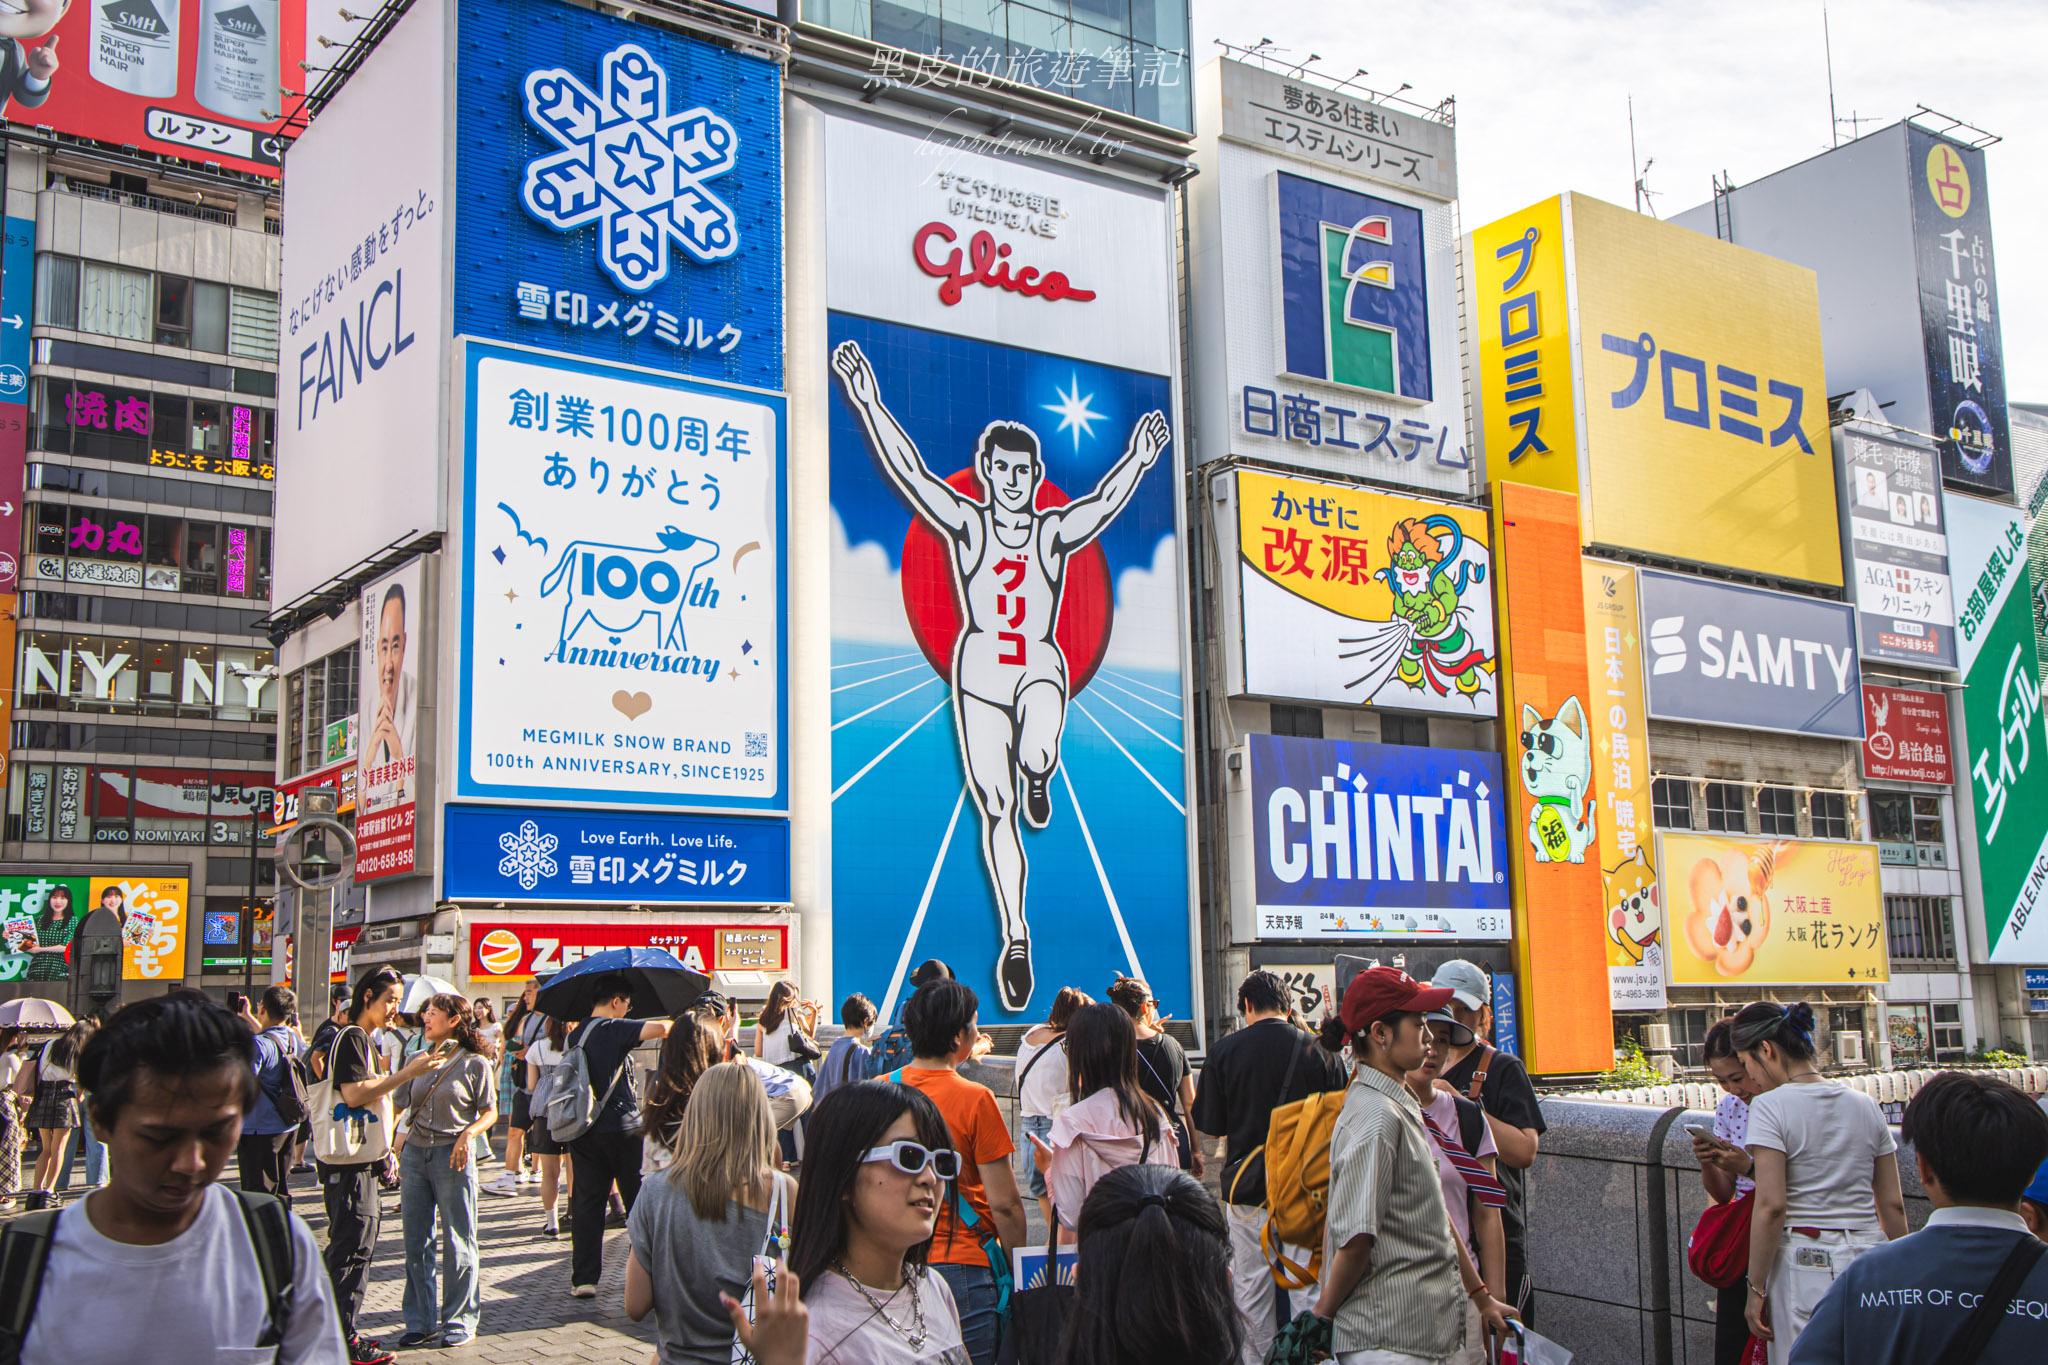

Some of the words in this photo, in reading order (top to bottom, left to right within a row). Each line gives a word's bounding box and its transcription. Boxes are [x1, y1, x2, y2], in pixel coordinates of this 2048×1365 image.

[118, 11, 158, 32] SMH
[227, 17, 257, 33] SMH
[99, 54, 129, 72] HAIR
[100, 34, 141, 55] SUPER
[100, 45, 145, 66] MILLION
[1282, 84, 1400, 138] 夢ある住まい
[157, 116, 232, 145] ルアン
[1264, 116, 1421, 182] エステムシリーズ
[1936, 147, 1963, 210] 占
[949, 196, 1058, 239] ゆたかな人生
[289, 188, 434, 336] なにげない感動をずっと。
[912, 220, 1097, 307] Glico
[1971, 235, 1991, 323] 占いの館
[516, 280, 743, 355] 雪印メグミルク
[1939, 227, 1983, 394] 千里眼
[298, 267, 415, 432] FANCL
[1496, 226, 1554, 465] プロミス
[1601, 331, 1816, 456] プロミス
[65, 390, 151, 437] 焼肉
[508, 387, 752, 462] 創業100周年
[1243, 385, 1470, 469] 日商エステム
[543, 451, 721, 511] ありがとう
[1271, 490, 1360, 531] かぜに
[39, 525, 62, 535] OPEN
[69, 517, 143, 556] 力丸
[68, 561, 140, 585] 特選焼肉
[1261, 526, 1371, 587] 改源
[1864, 566, 1895, 588] AGA
[1913, 577, 1944, 596] スキン
[1958, 520, 2025, 642] お部屋探しは
[992, 553, 1029, 666] グリコ
[1881, 592, 1932, 618] クリニック
[543, 638, 720, 683] Anniversary
[1698, 624, 1853, 695] SAMTY
[522, 727, 606, 747] MEGMILK
[613, 733, 666, 751] SNOW
[672, 738, 732, 755] BRAND
[1898, 740, 1946, 765] 鳥治食品
[486, 752, 535, 769] 100th
[27, 772, 48, 834] 焼きそば
[60, 766, 79, 839] お好み焼き
[404, 809, 415, 827] 2F
[580, 830, 616, 846] Love
[619, 831, 665, 847] Earth.
[671, 833, 704, 848] Love
[707, 834, 738, 850] Life.
[1544, 817, 1567, 851] 福
[569, 852, 748, 887] 雪印メグミルク
[1265, 914, 1304, 931] 天気予報
[1783, 895, 1833, 915] 大阪土産
[649, 935, 689, 945] ゼッテリア
[724, 933, 776, 944] 絶品バーガー
[741, 956, 776, 966] コーヒー
[1613, 974, 1658, 985] www.jsv.jp
[1860, 1288, 1923, 1309] MATTER
[1927, 1288, 1953, 1306] OF
